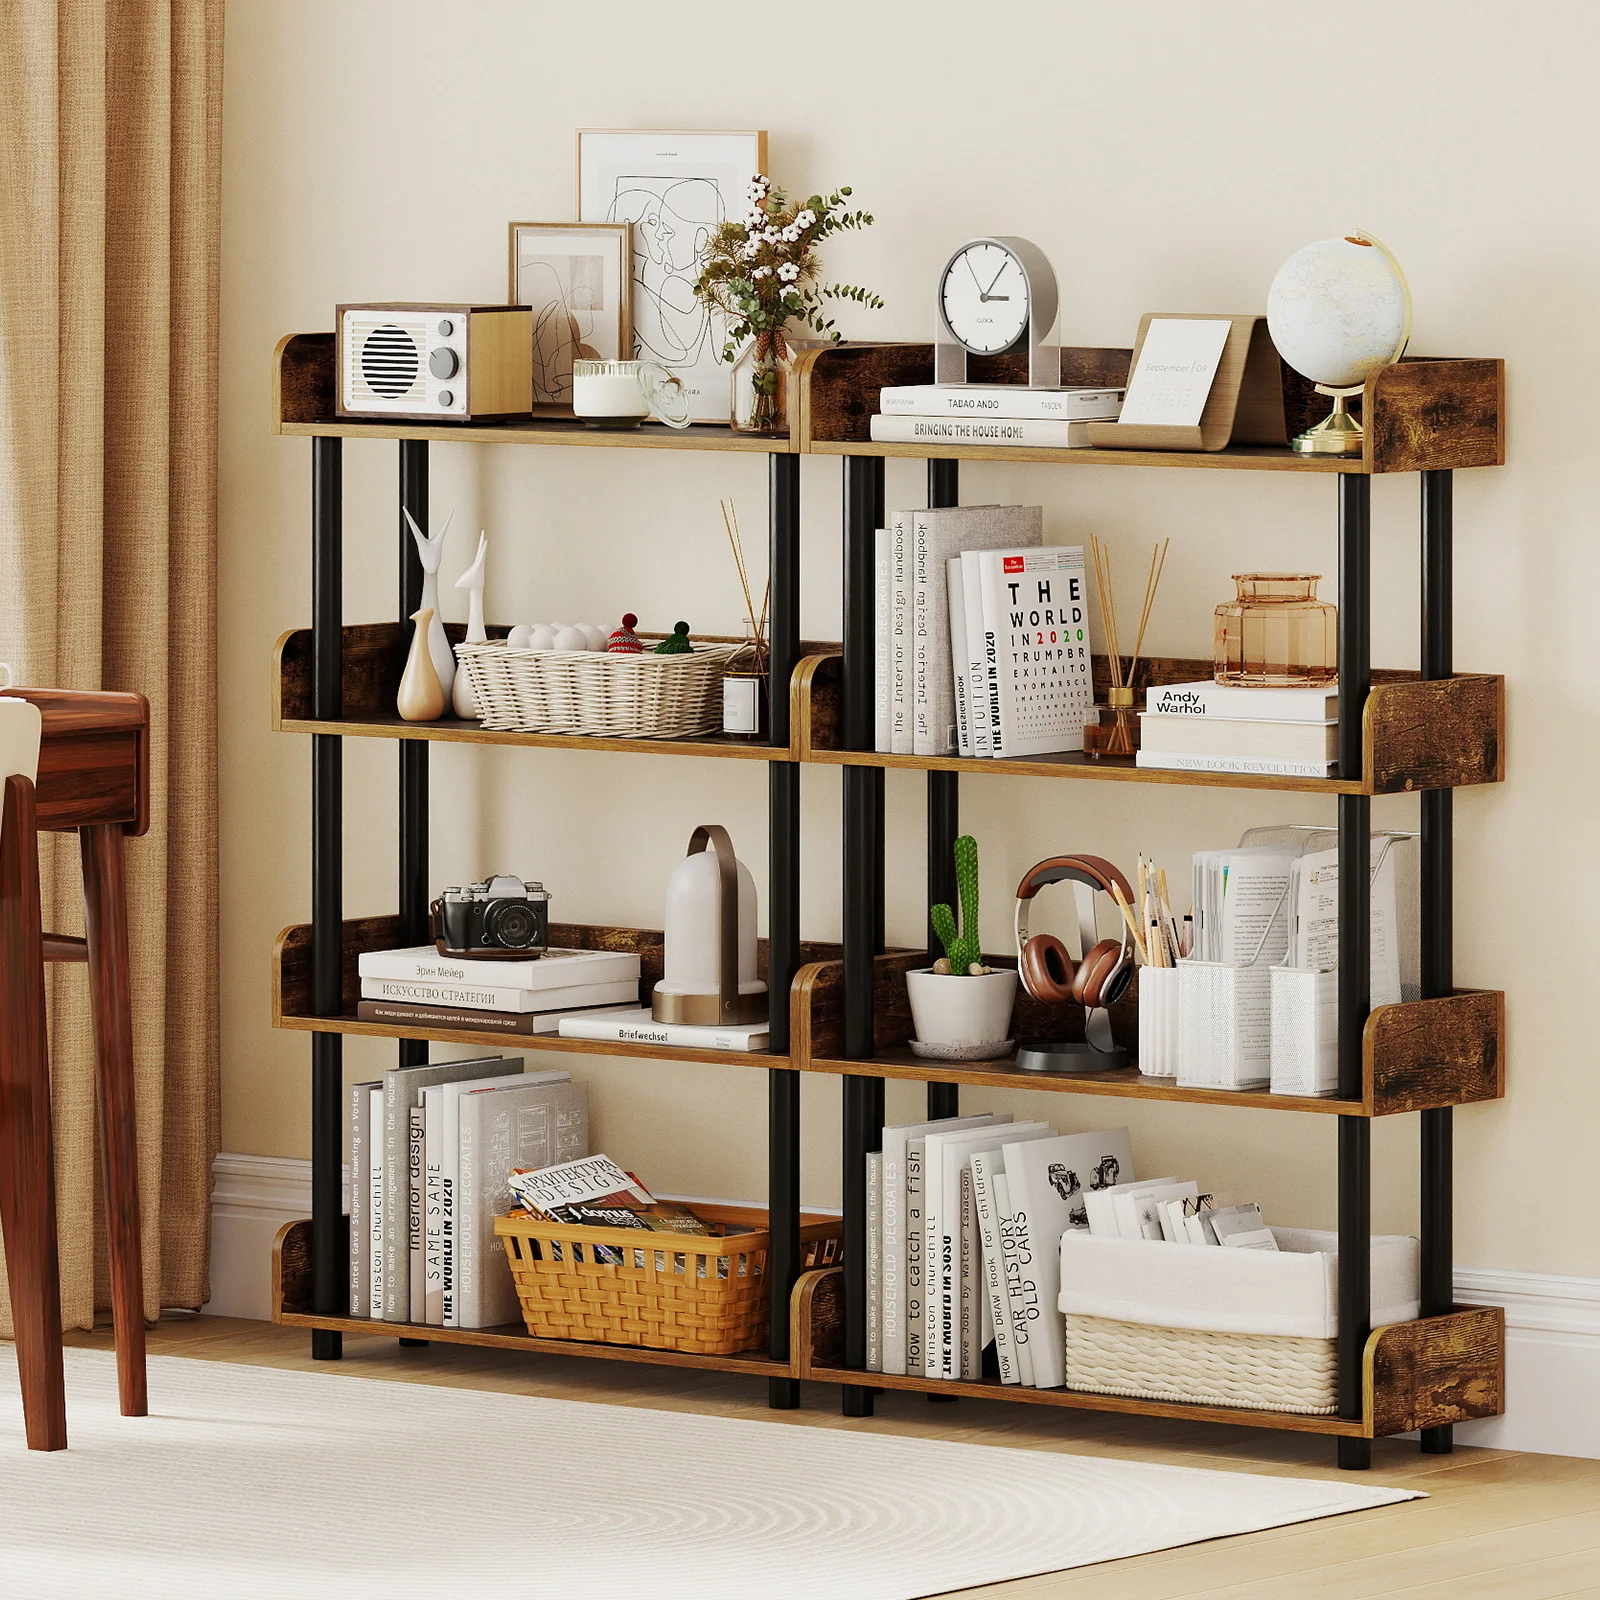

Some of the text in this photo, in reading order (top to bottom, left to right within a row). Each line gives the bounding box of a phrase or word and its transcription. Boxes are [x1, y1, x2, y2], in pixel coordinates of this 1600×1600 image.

[1145, 363, 1208, 373] September 09
[948, 399, 974, 408] TADAO
[976, 400, 999, 409] ANDO
[914, 423, 1024, 439] BRINGING THE HOUSE HOME
[1008, 578, 1080, 605] THE
[893, 522, 906, 733] The Interior Design Handbook
[1010, 607, 1082, 628] WORLD
[878, 560, 888, 718] HOUSEHOLD DECORATES
[1011, 629, 1083, 647] IN 2020
[1013, 647, 1085, 663] TRUMPBR
[970, 661, 988, 751] INTUITION
[985, 631, 1002, 751] THE WORLD IN 2020
[1157, 703, 1206, 714] Warhol
[1163, 691, 1200, 705] Andy
[1176, 759, 1321, 775] NEW LOOK REVOLUTION
[416, 965, 464, 981] Эрин Мейер
[382, 984, 495, 1005] ИСКУССТВО СТРАТЕГИИ
[618, 1029, 668, 1042] Briefwechsel
[351, 1090, 360, 1120] Voice
[351, 1137, 362, 1179] Hawking
[521, 1159, 618, 1191] АРХИТЕКТУРА
[387, 1076, 397, 1313] How to make an arrangement in the house
[410, 1115, 425, 1252] Interior design
[539, 1170, 627, 1202] DESIGN
[351, 1184, 361, 1225] Stephen
[427, 1163, 440, 1280] SAME SAME
[461, 1126, 472, 1293] HOUSEHOLD DECORATES
[580, 1205, 634, 1219] domus
[352, 1230, 360, 1255] Gave
[372, 1166, 382, 1310] Winston Churchill
[443, 1178, 453, 1321] THE WORLD IN 2020
[885, 1162, 897, 1338] HOUSEHOLD DECORATES
[351, 1260, 359, 1289] Intel
[869, 1158, 878, 1364] How to make an arrangement in the house
[907, 1151, 921, 1367] How to catch a fish
[961, 1171, 972, 1376] Steve Jobs by Walter Isaacson
[974, 1158, 1011, 1379] HOW TO DRAW Book for children
[1012, 1211, 1040, 1321] OLD CARS
[926, 1215, 936, 1368] Winston Churchill
[999, 1215, 1029, 1345] CAR HISTORY
[351, 1293, 359, 1313] How
